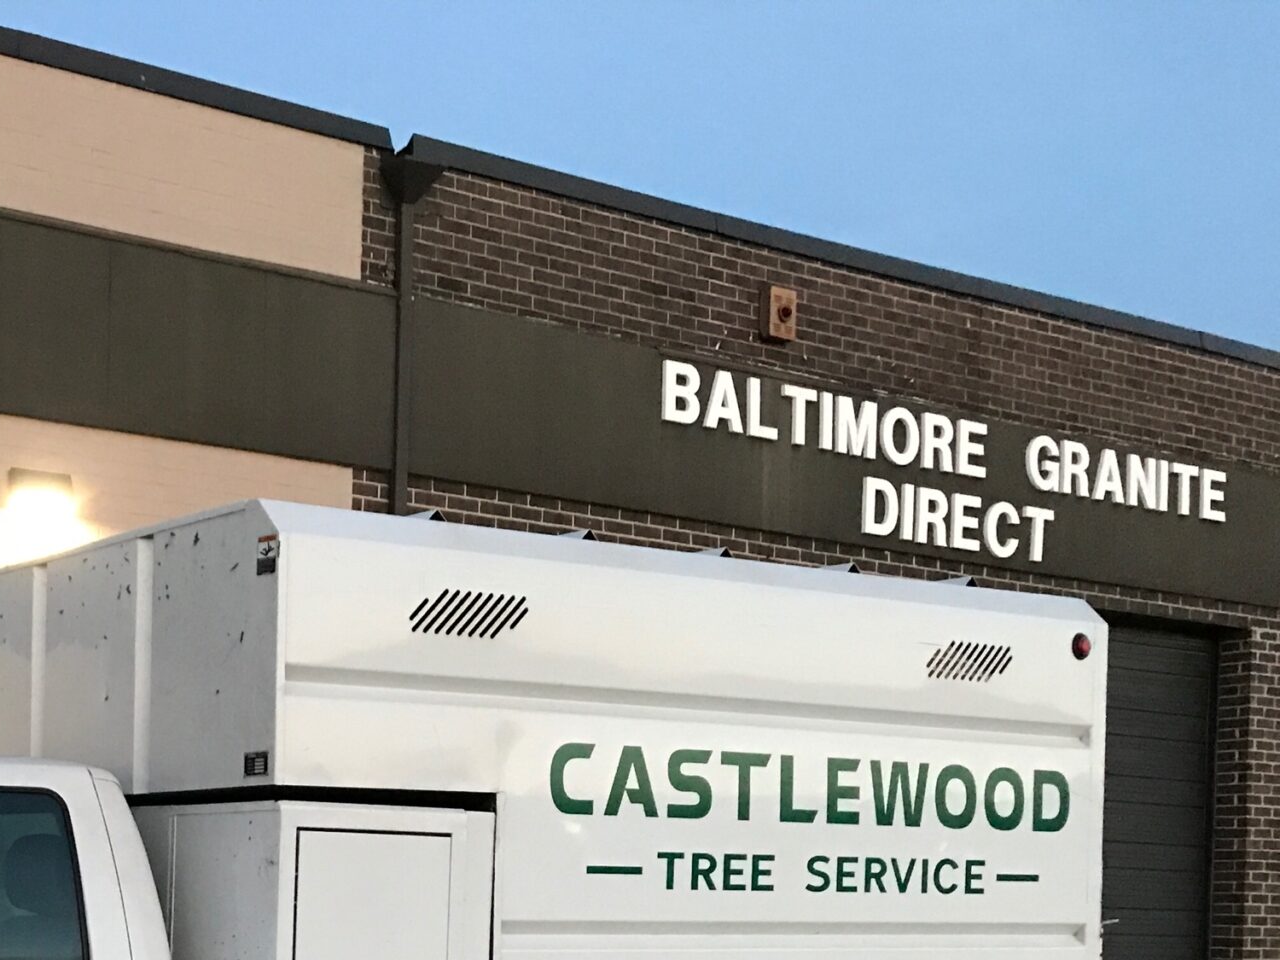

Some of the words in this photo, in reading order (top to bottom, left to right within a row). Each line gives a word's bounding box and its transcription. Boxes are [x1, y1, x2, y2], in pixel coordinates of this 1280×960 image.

[661, 358, 988, 479] BALTIMORE
[1026, 435, 1227, 522] GRANITE
[862, 476, 1055, 562] DIRECT
[550, 742, 1070, 832] CASTLEWOOD
[657, 851, 776, 891] TREE
[805, 855, 986, 894] SERVICE
